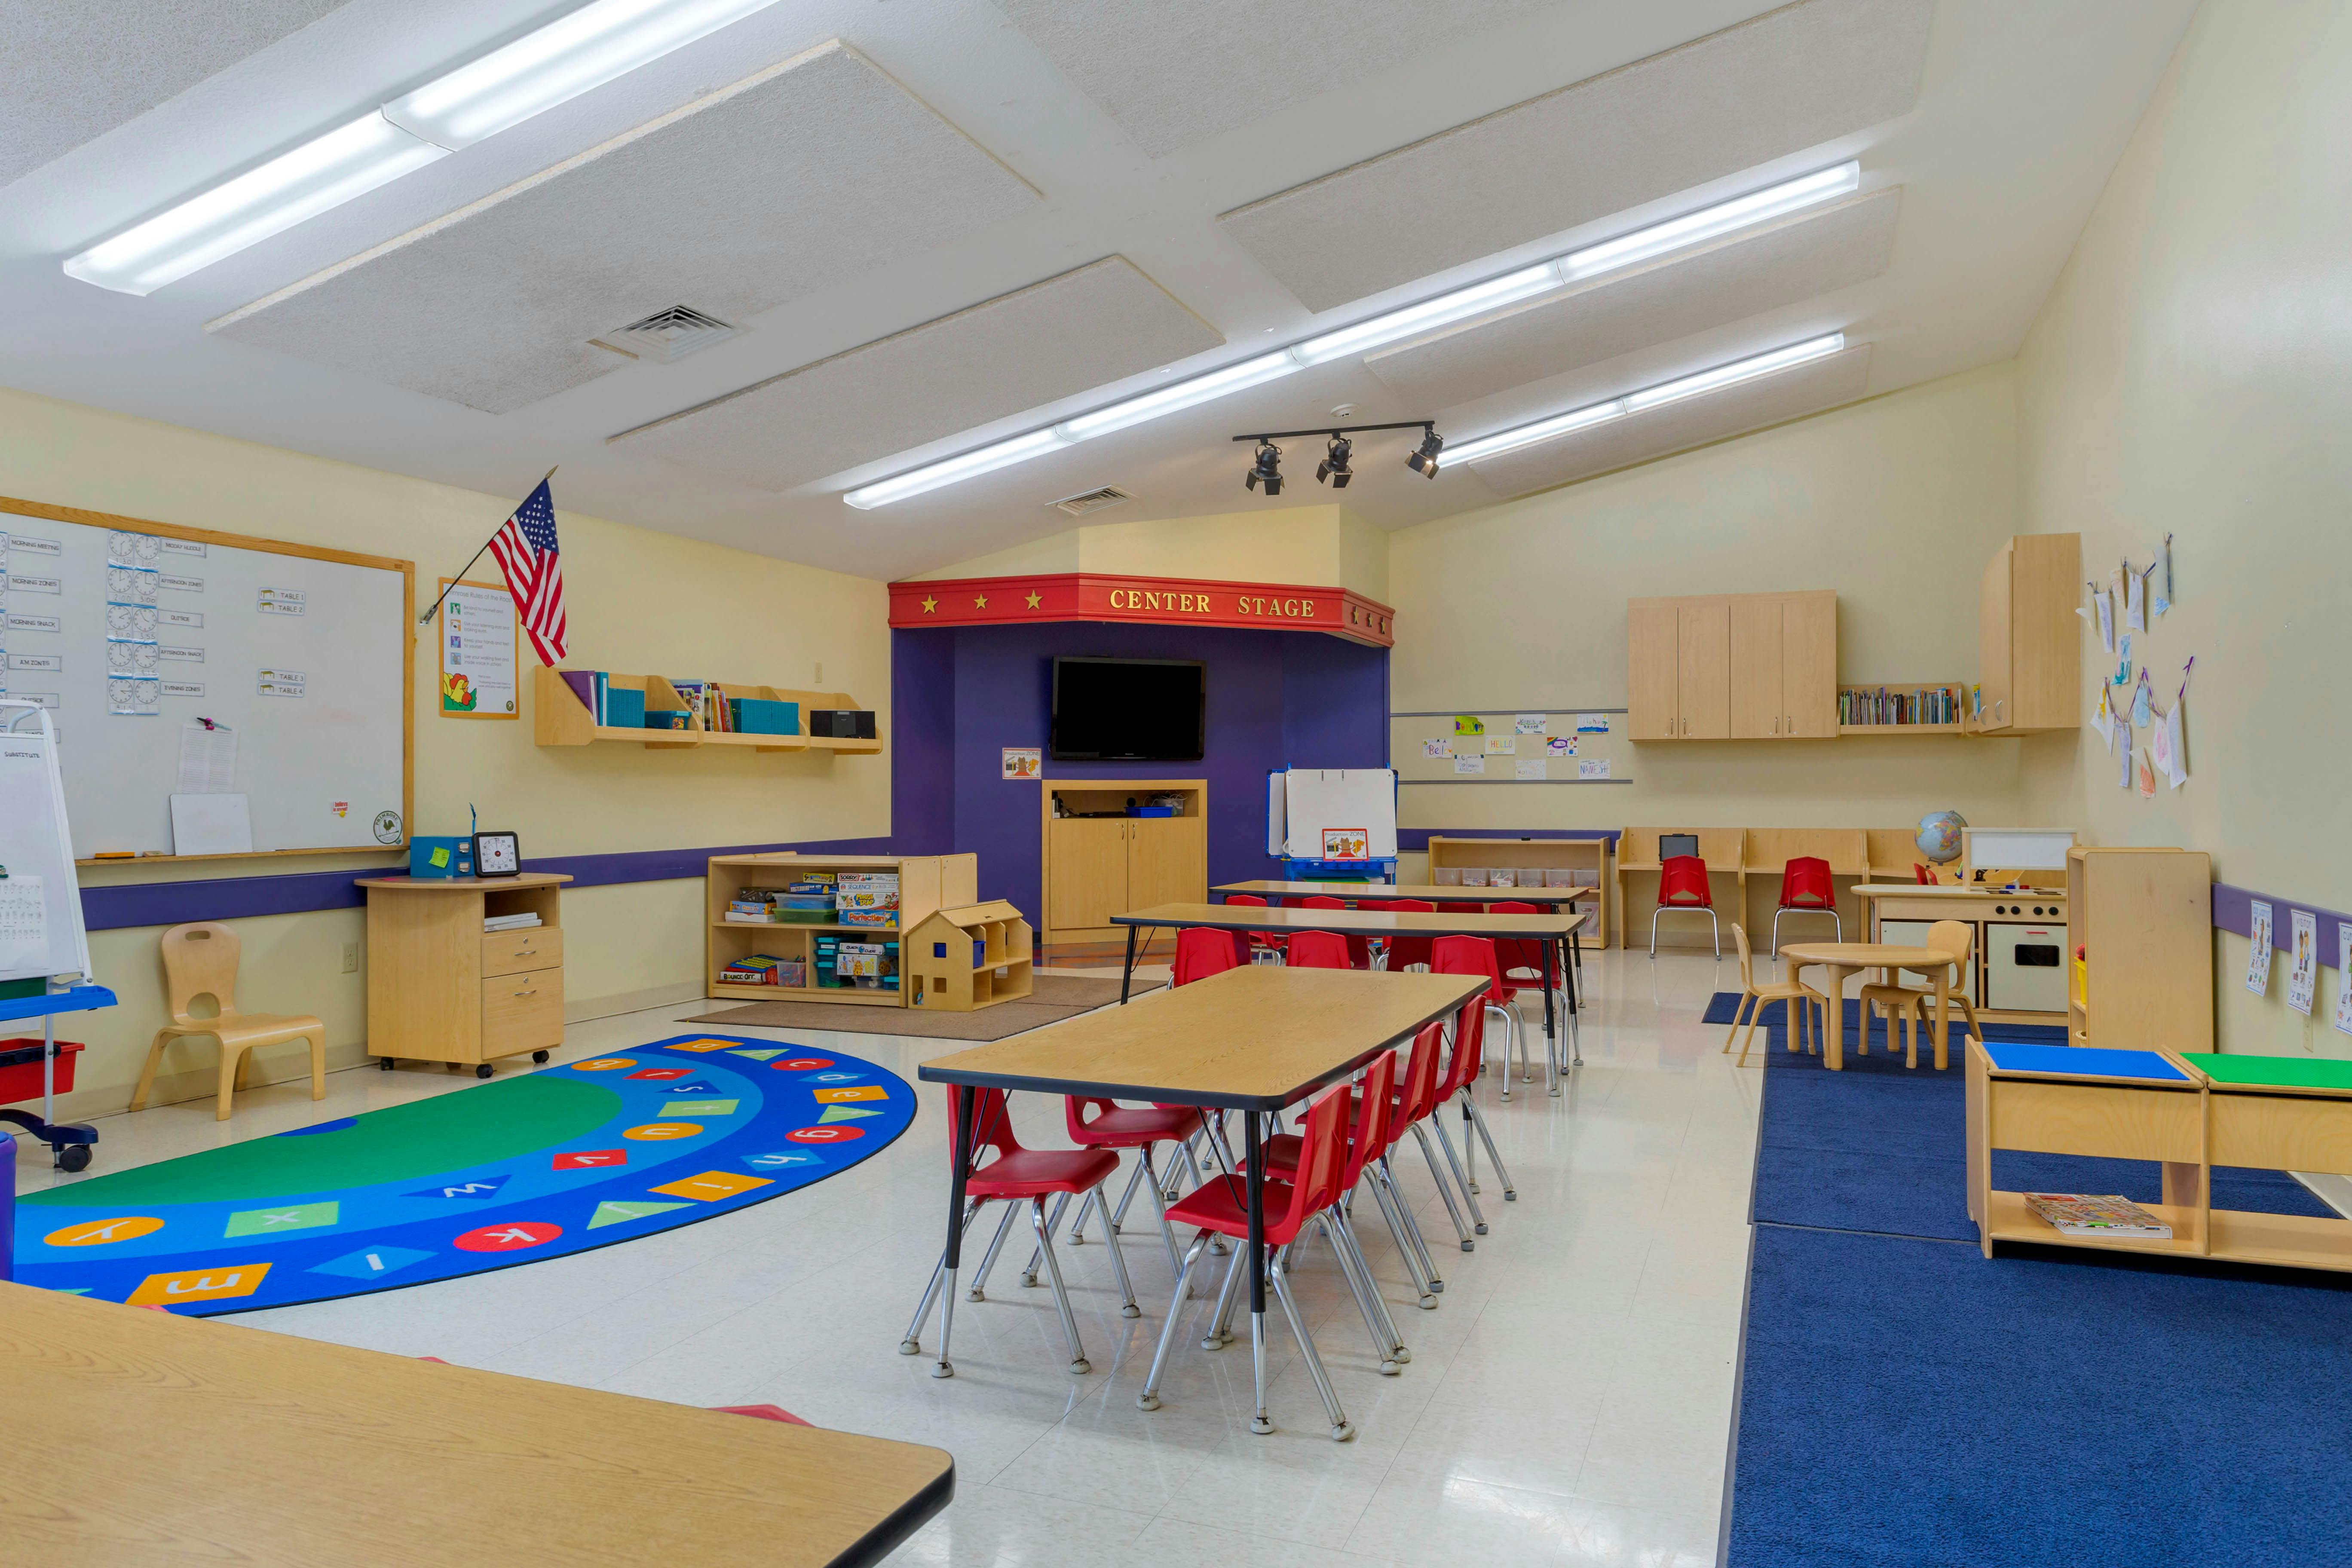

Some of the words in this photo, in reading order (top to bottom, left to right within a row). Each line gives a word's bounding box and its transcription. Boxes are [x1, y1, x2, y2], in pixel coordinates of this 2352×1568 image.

[1110, 590, 1211, 613] CENTER
[1237, 596, 1314, 617] STAGE
[1491, 740, 1513, 748] HELLO
[375, 812, 398, 825] PRIMROSE
[848, 912, 885, 922] Perfection
[752, 1155, 807, 1164] h
[165, 1273, 242, 1295] m
